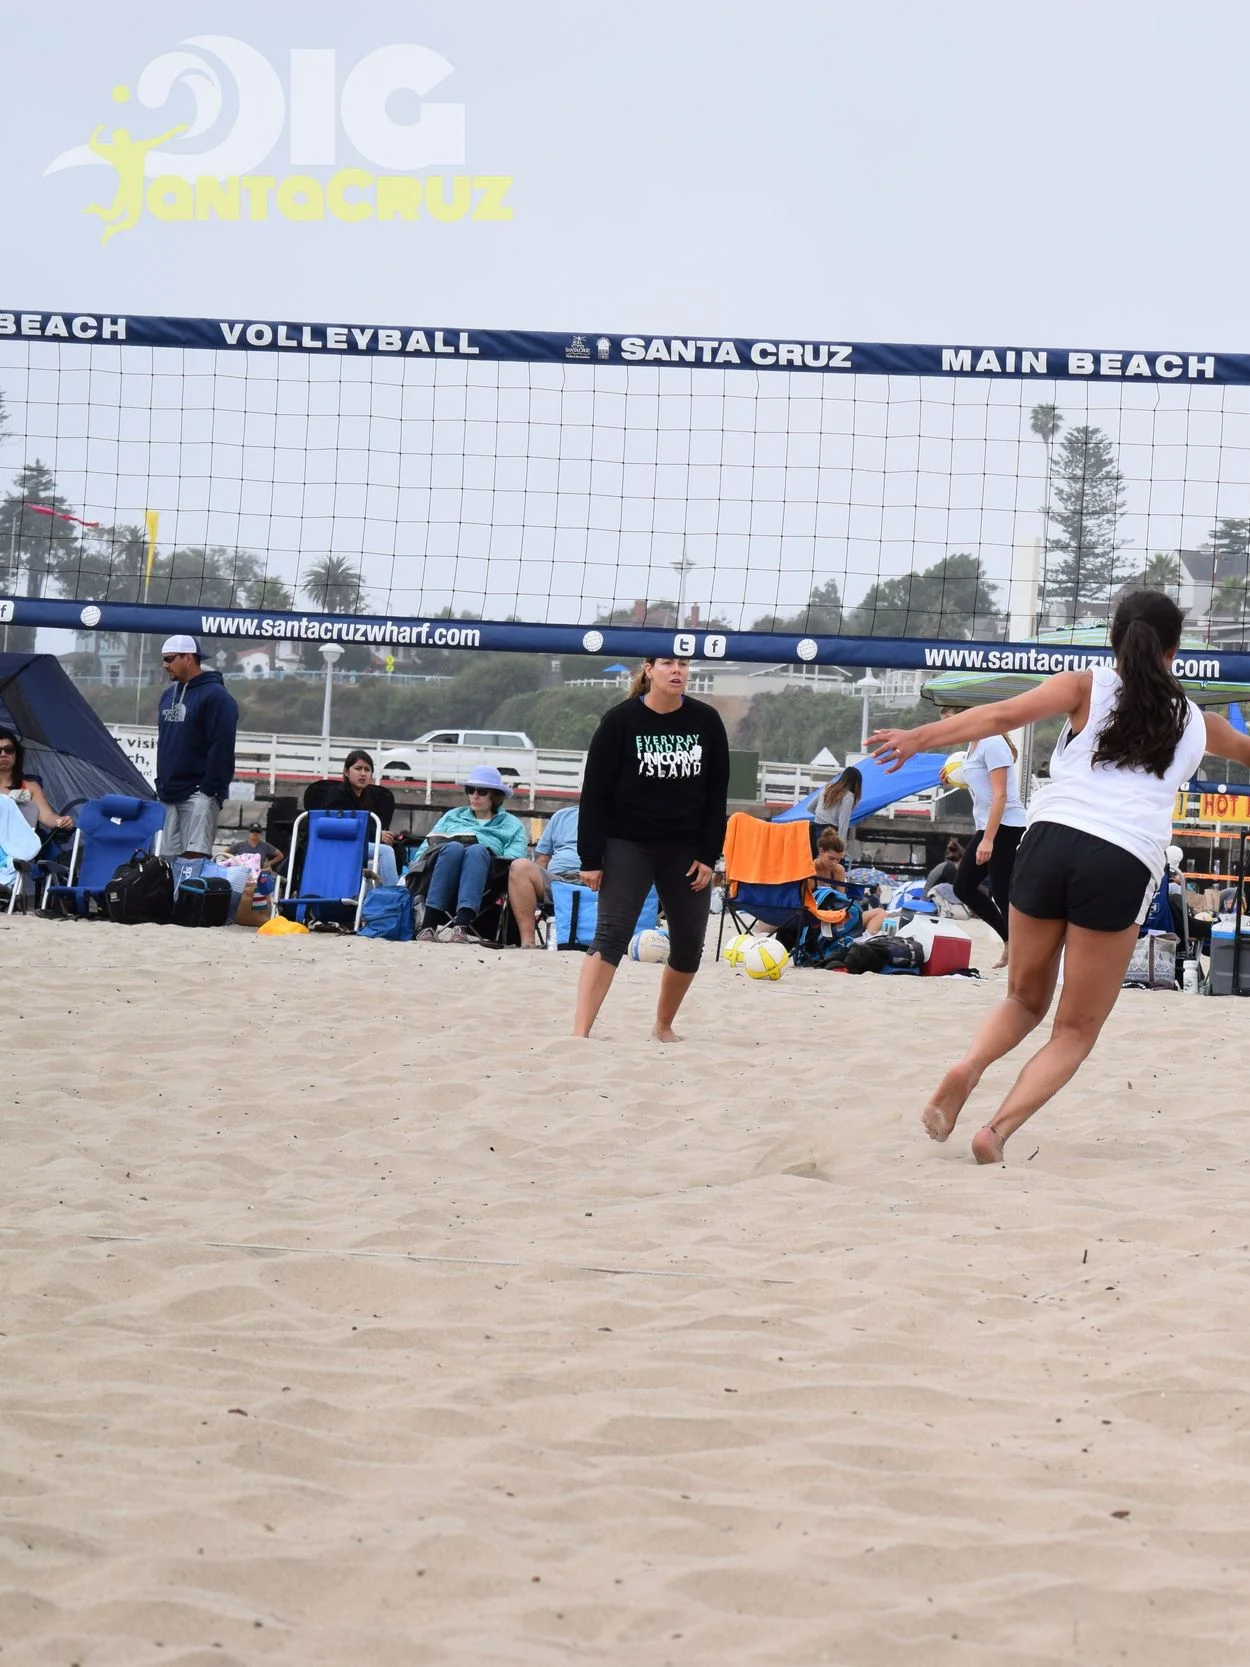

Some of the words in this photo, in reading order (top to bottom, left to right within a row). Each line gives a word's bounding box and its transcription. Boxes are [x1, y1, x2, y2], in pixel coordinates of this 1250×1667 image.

[0, 312, 127, 340] BEACH
[219, 321, 481, 355] VOLLEYBALL
[620, 337, 741, 364] SANTA
[750, 341, 852, 368] CRUZ
[941, 348, 1047, 374] MAIN
[1068, 352, 1215, 379] BEACH
[201, 615, 481, 647] www.santacruzwharf.com
[924, 648, 1220, 678] www.santacruzwcom
[636, 734, 699, 745] EVERYDAY
[637, 743, 690, 753] FUNDAY
[638, 751, 696, 765] UNICORN
[639, 761, 701, 776] ISLAND
[1204, 793, 1239, 818] HOT
